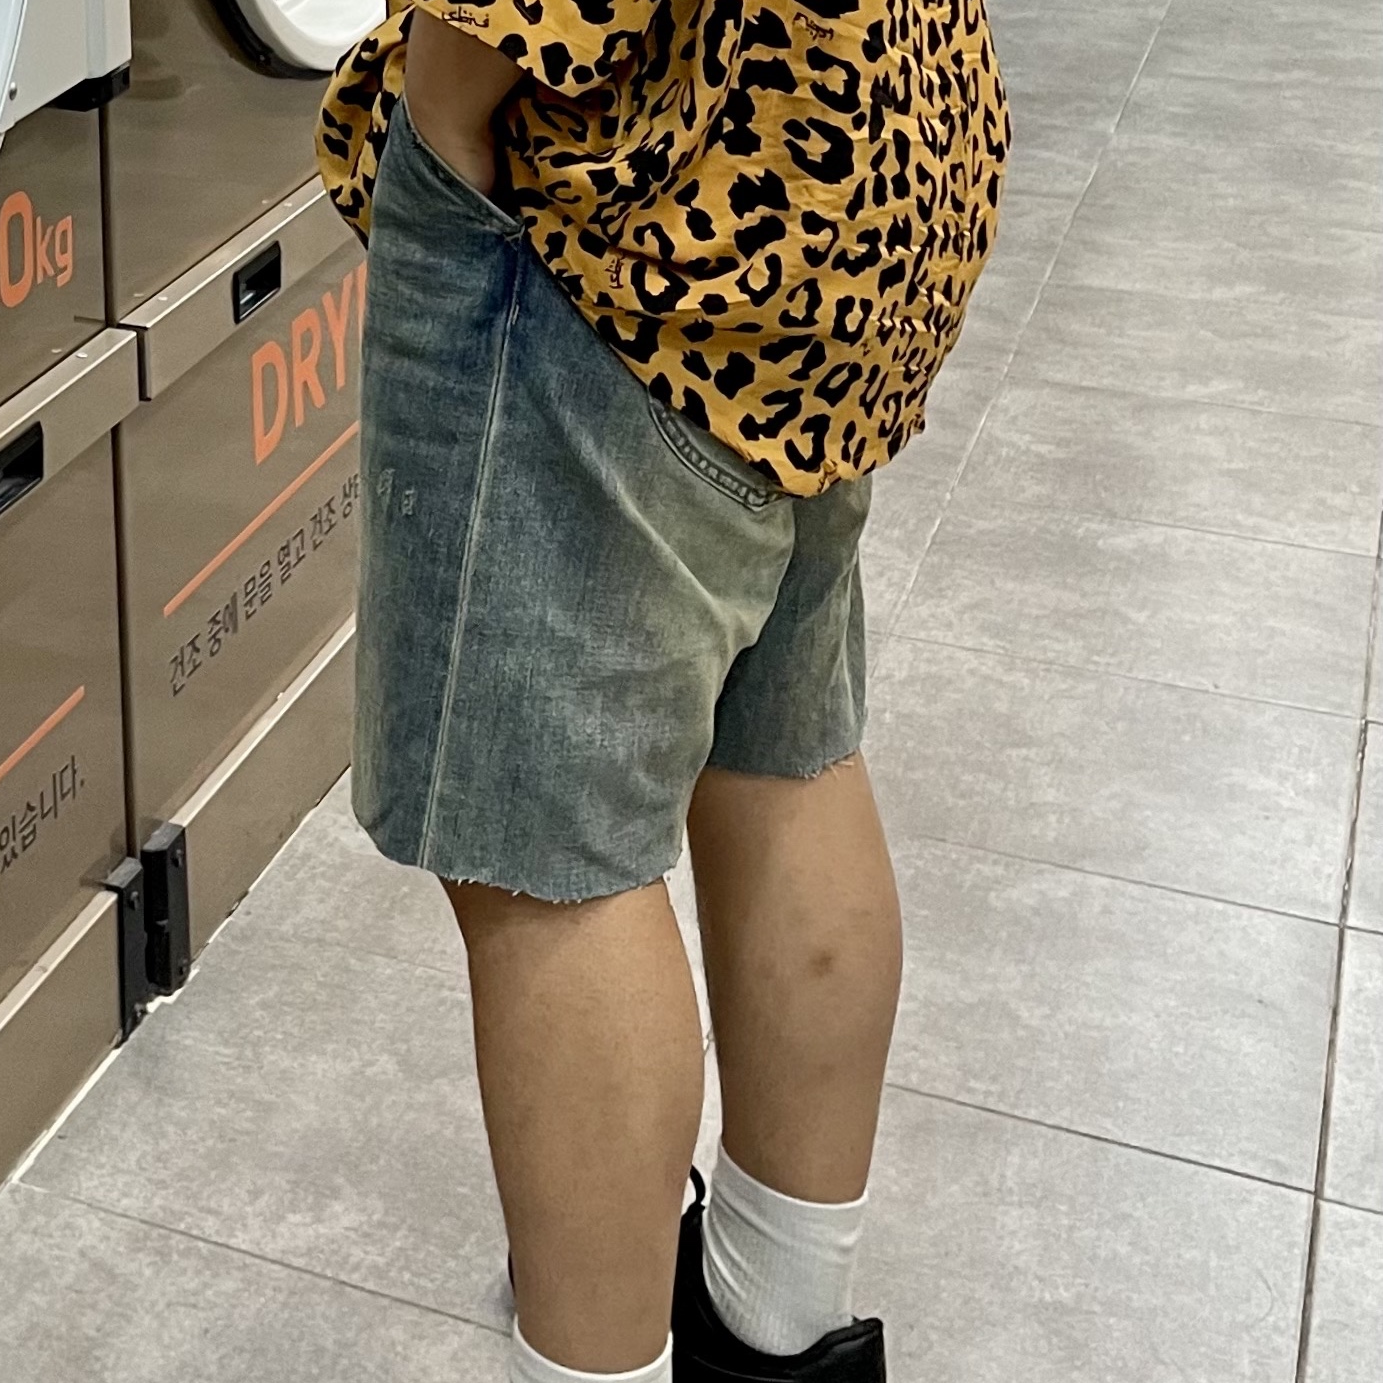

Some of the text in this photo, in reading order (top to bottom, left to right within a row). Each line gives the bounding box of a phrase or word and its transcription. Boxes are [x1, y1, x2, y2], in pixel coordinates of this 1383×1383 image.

[170, 633, 203, 697] 건조
[207, 591, 239, 658] 중에
[243, 559, 273, 621] 문을
[278, 527, 306, 586] 열고
[309, 496, 337, 551] 건조
